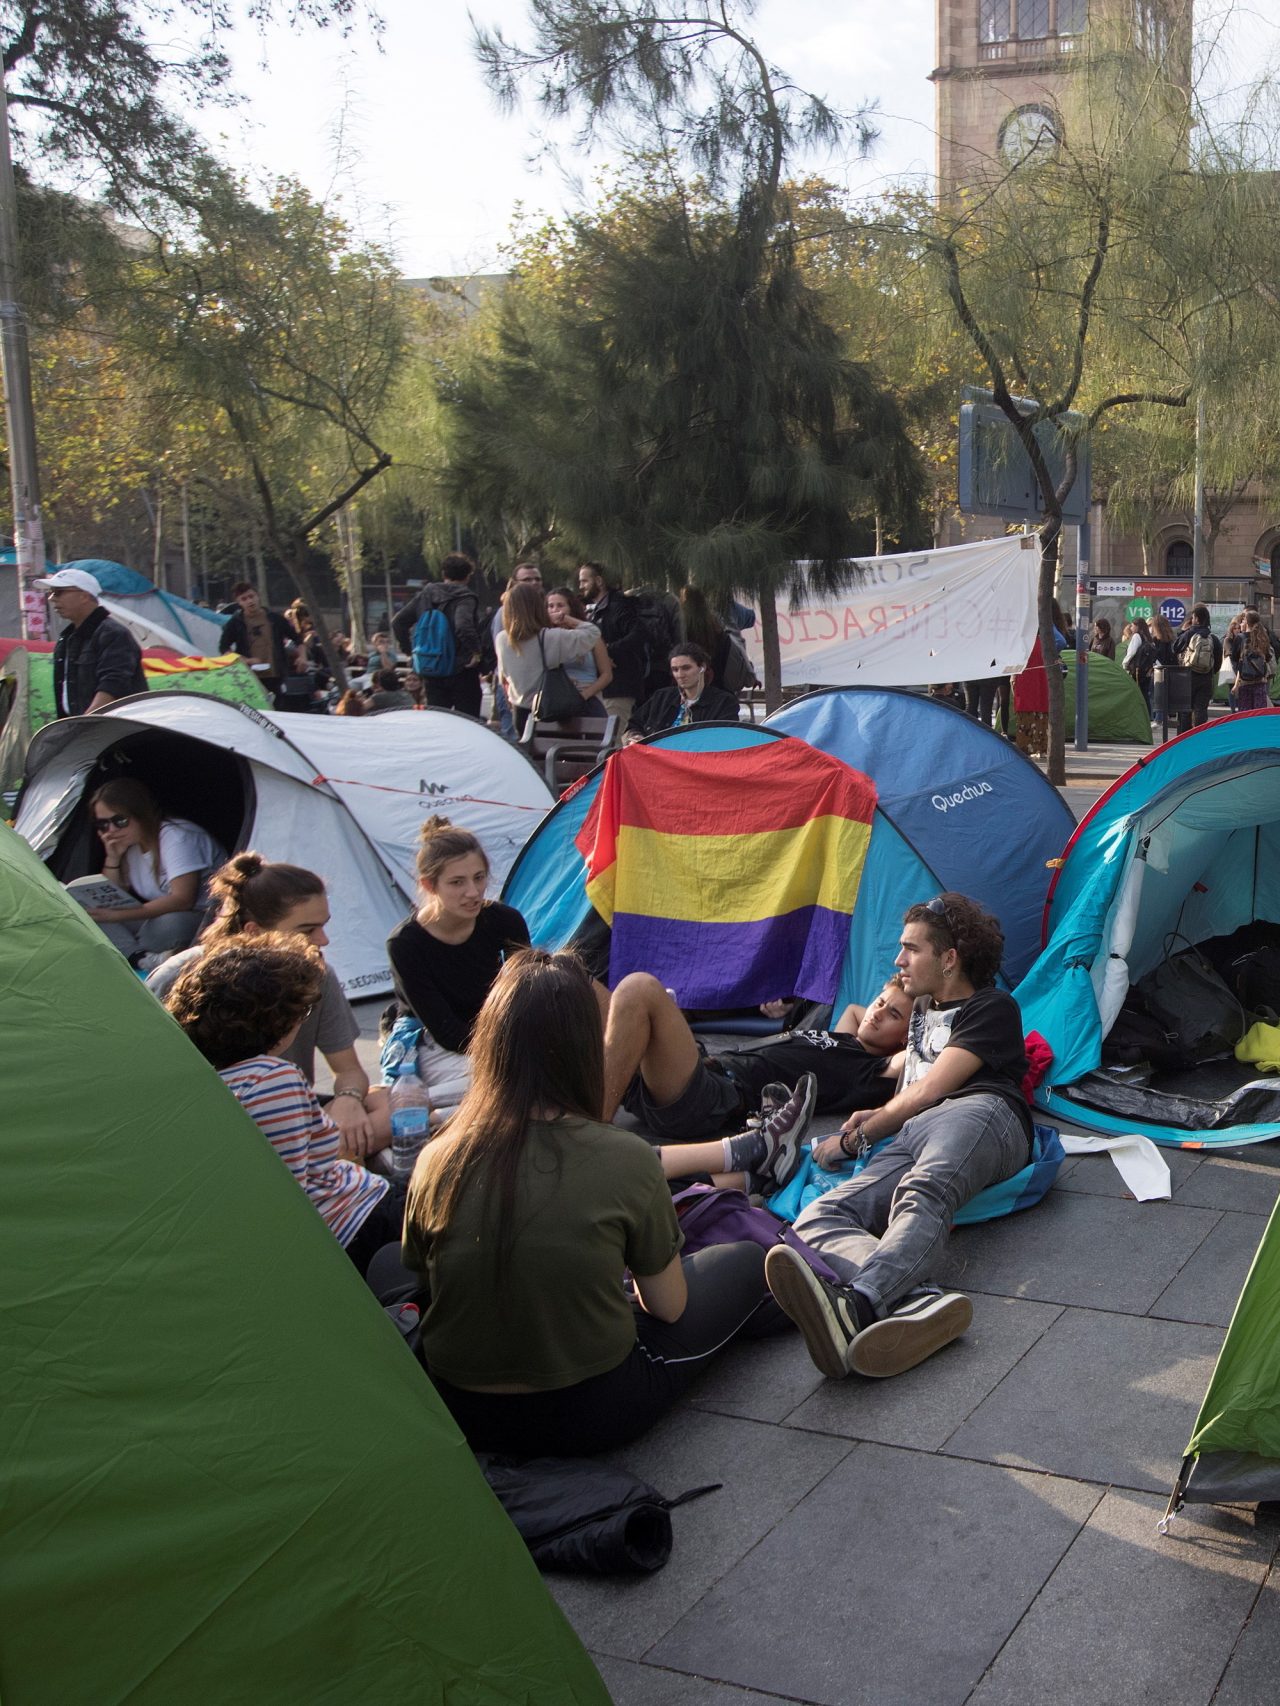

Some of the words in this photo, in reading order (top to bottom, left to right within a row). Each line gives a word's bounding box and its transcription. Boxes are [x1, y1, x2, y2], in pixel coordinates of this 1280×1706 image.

[1128, 606, 1152, 618] V13
[1160, 606, 1185, 619] H12
[931, 782, 993, 813] Quechua
[347, 968, 394, 989] SECOND
